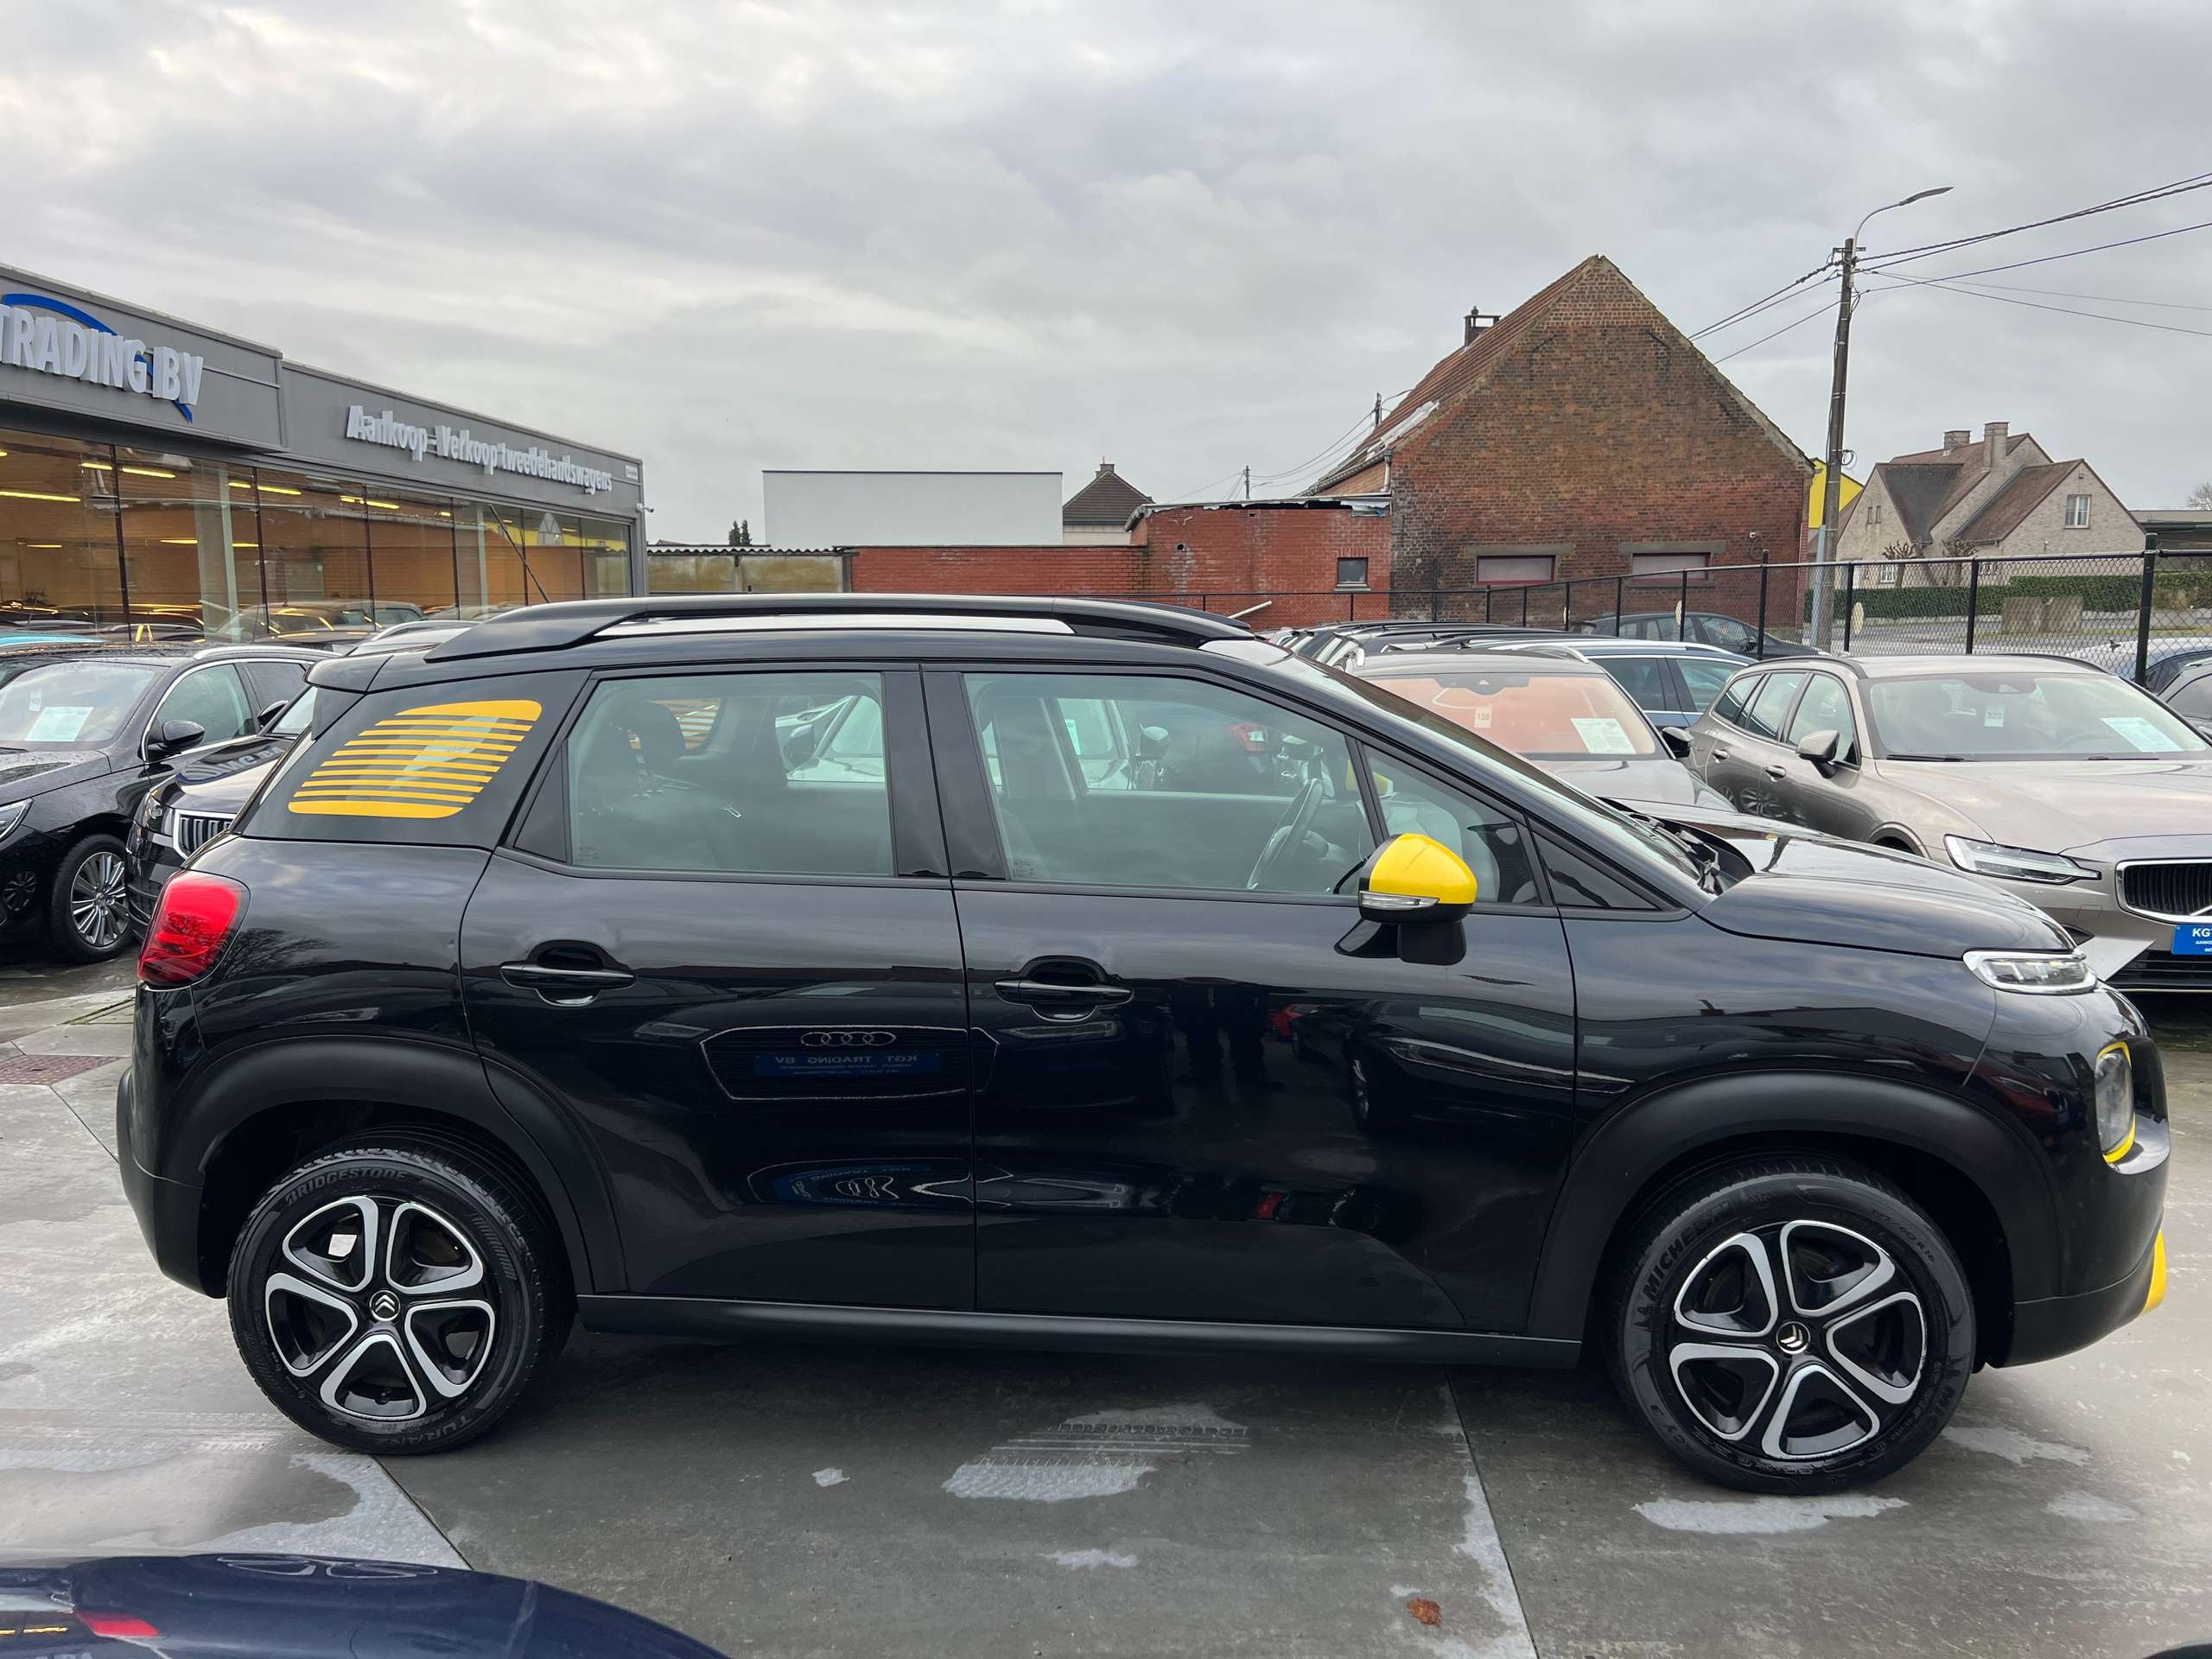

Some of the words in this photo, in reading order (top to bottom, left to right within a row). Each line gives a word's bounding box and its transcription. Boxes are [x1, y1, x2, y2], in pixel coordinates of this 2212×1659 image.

[153, 346, 203, 406] BV
[346, 405, 427, 461] Aankoop
[435, 425, 499, 476] Verkoop
[2192, 927, 2212, 938] KG
[284, 1167, 408, 1206] BRIDGESTONE
